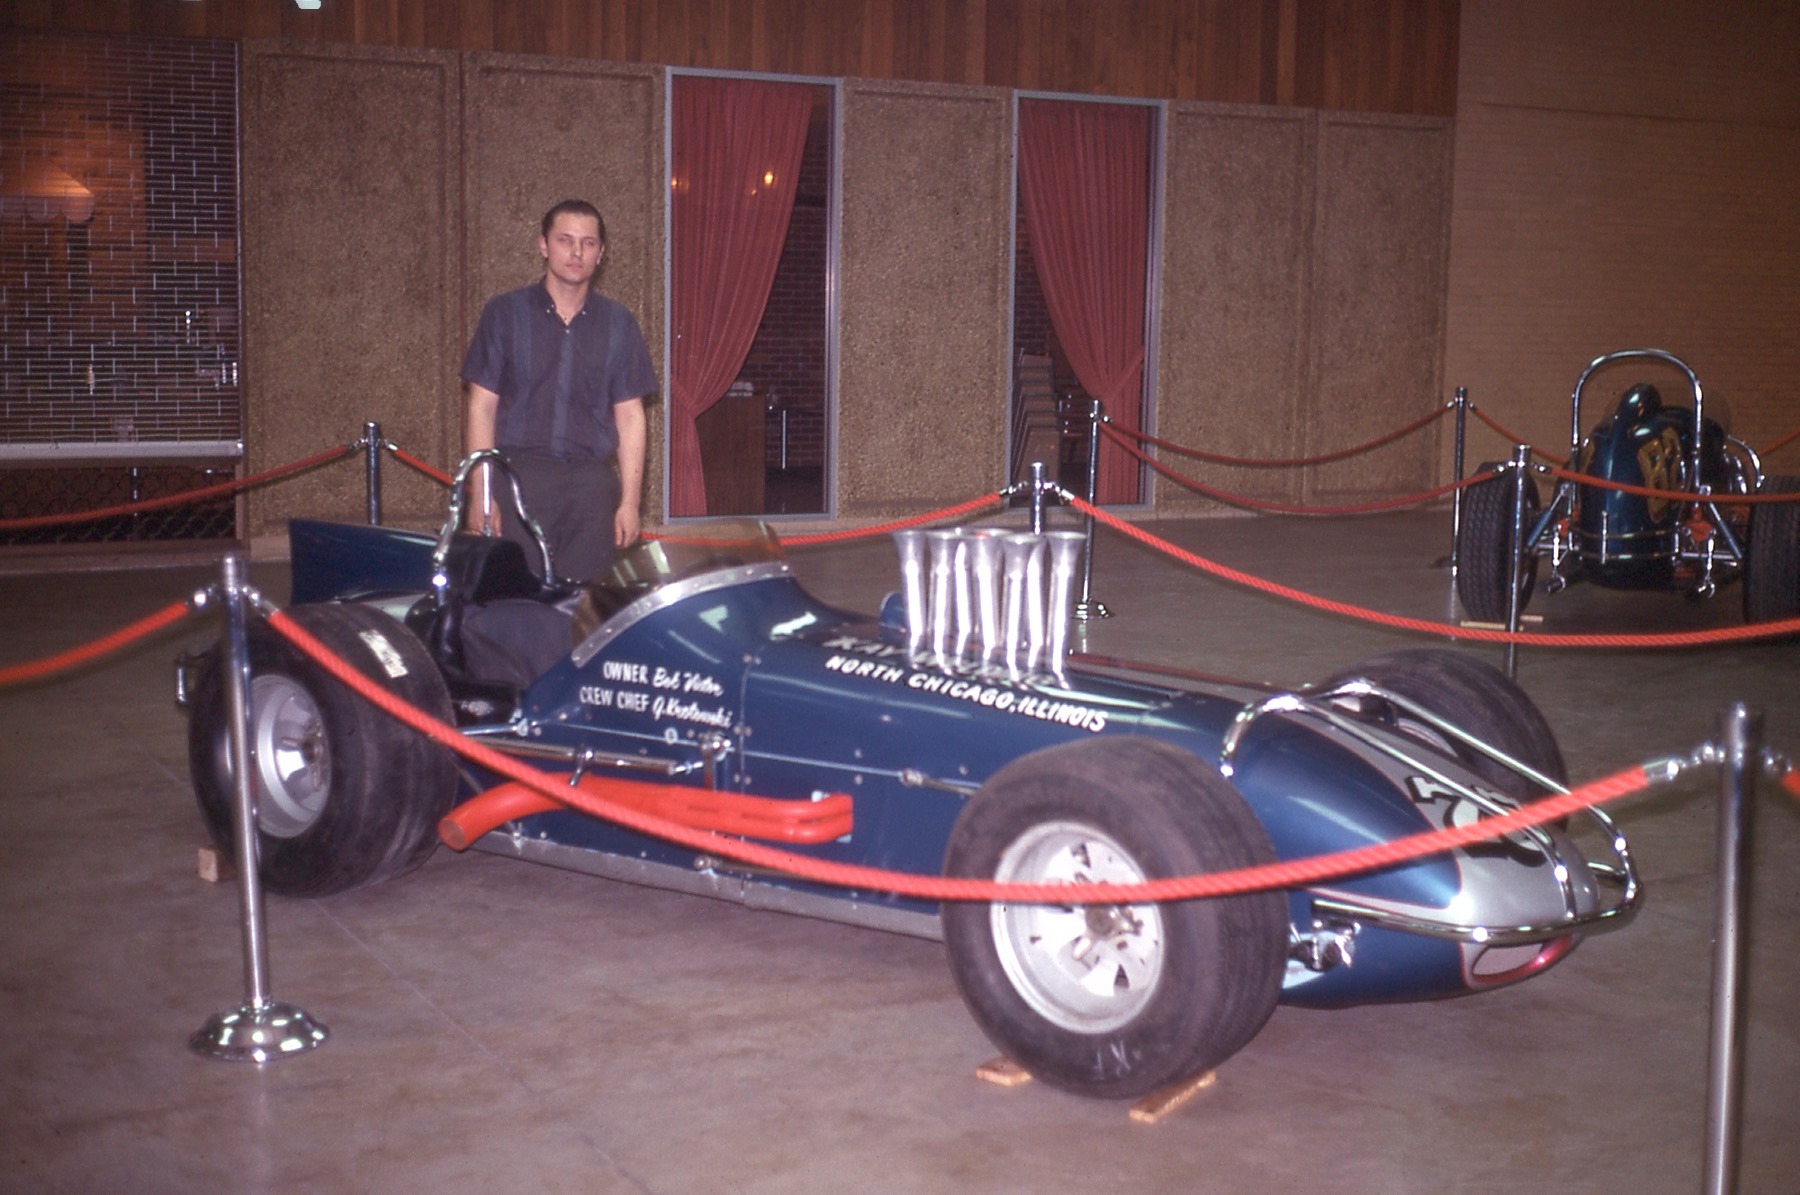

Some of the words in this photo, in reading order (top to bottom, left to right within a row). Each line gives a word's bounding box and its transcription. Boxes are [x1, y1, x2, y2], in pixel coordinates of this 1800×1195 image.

[603, 660, 649, 684] OWNER
[652, 666, 681, 689] Bob
[825, 655, 904, 684] NORTH
[579, 686, 613, 706] CREW
[617, 691, 650, 712] CHIEF
